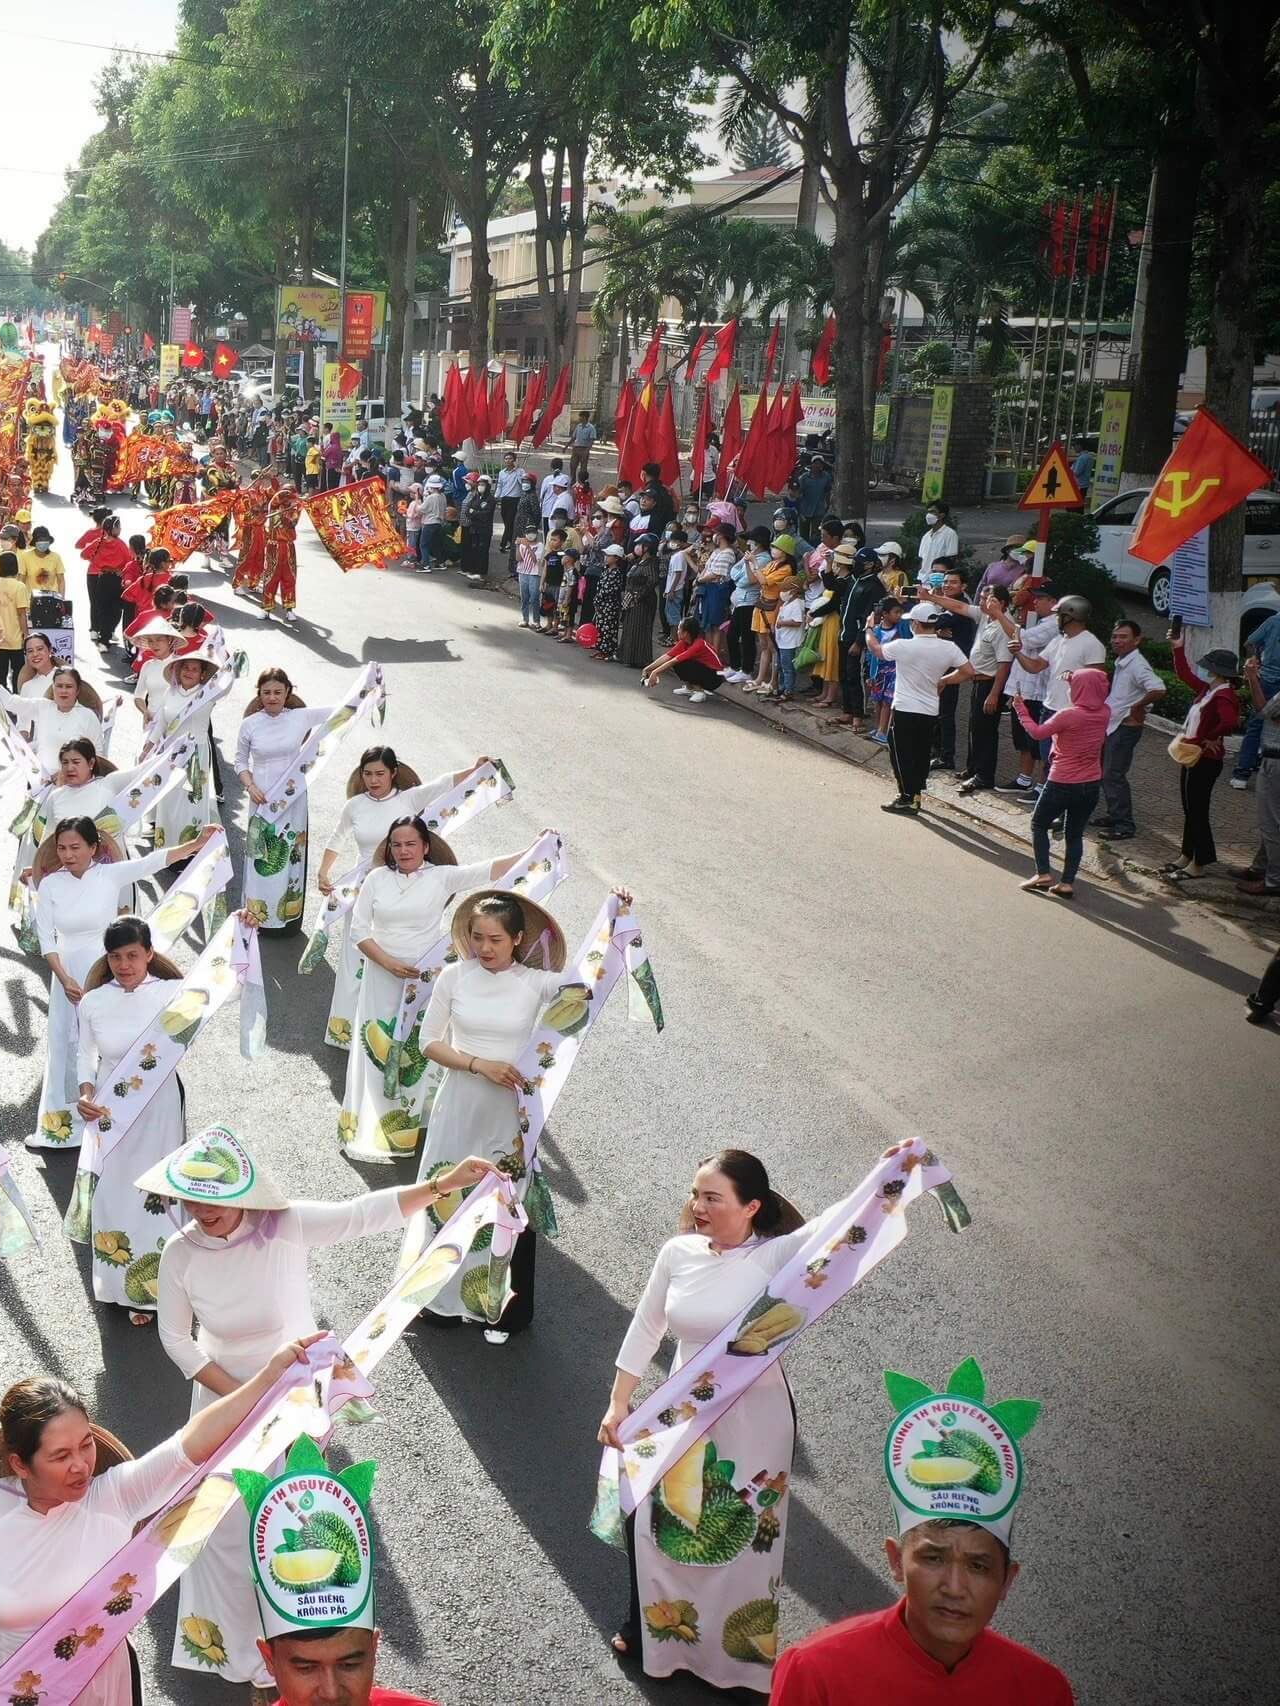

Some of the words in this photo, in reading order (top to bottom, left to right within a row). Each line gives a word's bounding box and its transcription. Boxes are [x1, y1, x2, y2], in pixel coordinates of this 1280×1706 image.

[893, 1420, 913, 1467] TRƯỜNG
[913, 1409, 929, 1422] TH
[931, 1402, 987, 1423] NGUYỄN
[930, 1500, 960, 1510] KRÔNG
[931, 1490, 949, 1501] SẦU
[951, 1492, 979, 1505] RIÊNG
[255, 1504, 273, 1562] TRƯỜNG
[271, 1489, 287, 1506] TH
[287, 1479, 342, 1498] NGUYỄN
[342, 1497, 356, 1515] BÁ
[355, 1516, 369, 1557] NGỌC
[297, 1590, 316, 1606] SẦU
[318, 1592, 346, 1605] RIÊNG
[296, 1602, 329, 1618] KRÔNG
[330, 1601, 349, 1616] PẮC
